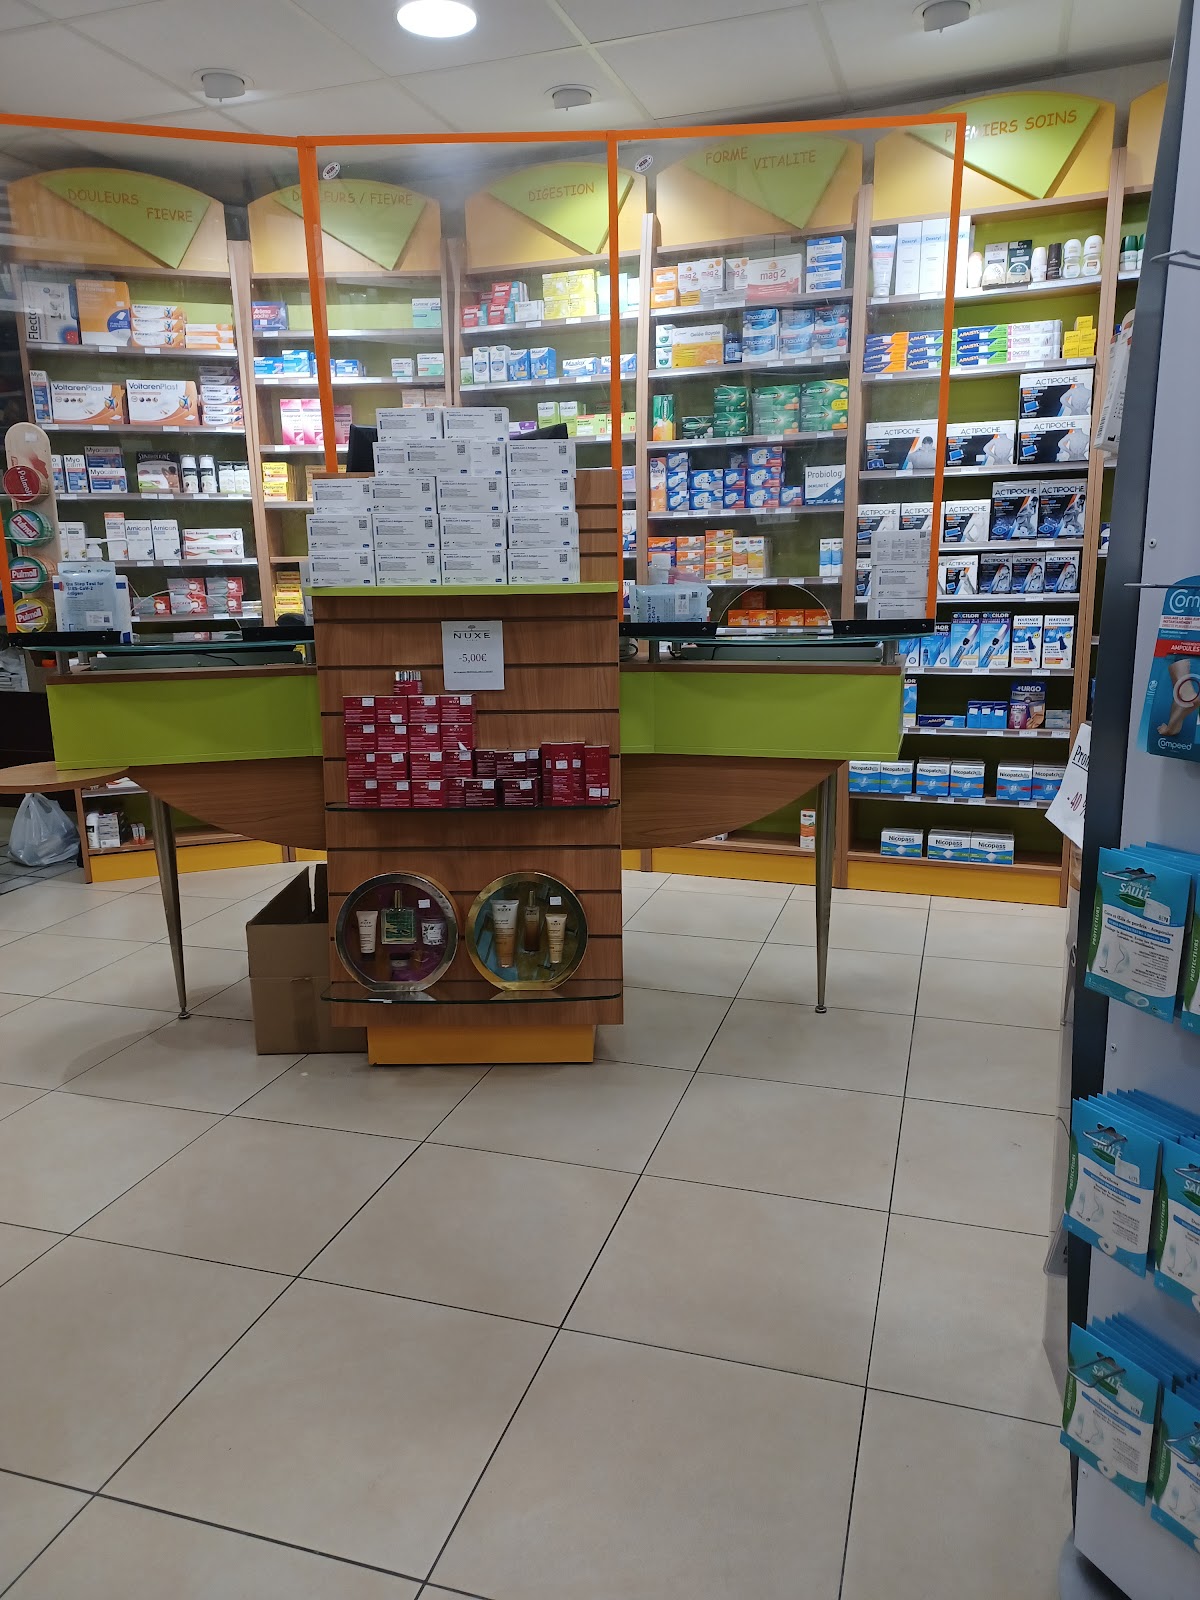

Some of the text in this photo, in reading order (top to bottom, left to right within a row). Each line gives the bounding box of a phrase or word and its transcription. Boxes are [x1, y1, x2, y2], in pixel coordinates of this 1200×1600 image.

[944, 109, 1078, 143] PEMIERS SOINS
[705, 146, 749, 166] FORME
[753, 149, 817, 170] VITALITE
[68, 188, 139, 205] DOULEURS
[528, 182, 595, 202] DIGESTION
[292, 192, 356, 204] DEURS
[370, 193, 413, 206] FIEVRE
[146, 207, 193, 223] FIEVRE
[760, 269, 787, 282] mag 2
[28, 305, 39, 340] Flector
[128, 382, 178, 390] VoltarenPlast
[1035, 376, 1079, 386] ACTIPOCHE
[52, 383, 104, 392] VoltarenPlast
[1033, 421, 1077, 430] ACTIPOCHE
[884, 427, 921, 436] ACTIPOCHE
[960, 427, 1001, 435] ACTIPOCHE
[66, 456, 80, 464] Myo
[807, 470, 842, 480] Probiolog
[994, 486, 1037, 496] ACTIPOCHE
[1041, 485, 1085, 495] ACTIPOCHE
[860, 508, 897, 516] ACTIPOCHE
[948, 505, 987, 513] ACTIPOCHE
[13, 515, 37, 538] Pulmoll
[11, 569, 37, 579] Pulmoll
[17, 608, 42, 622] Pulmoll
[1170, 644, 1200, 652] AMPOULES
[458, 653, 487, 664] -5,00€
[1157, 737, 1193, 751] Compeed
[888, 835, 915, 844] Nicopass
[935, 839, 963, 848] Nicopass
[978, 841, 1006, 850] Nicopass
[1118, 882, 1152, 900] SAULE
[1091, 906, 1101, 946] PROTECTEURS
[1189, 939, 1199, 982] PROTECTEURS
